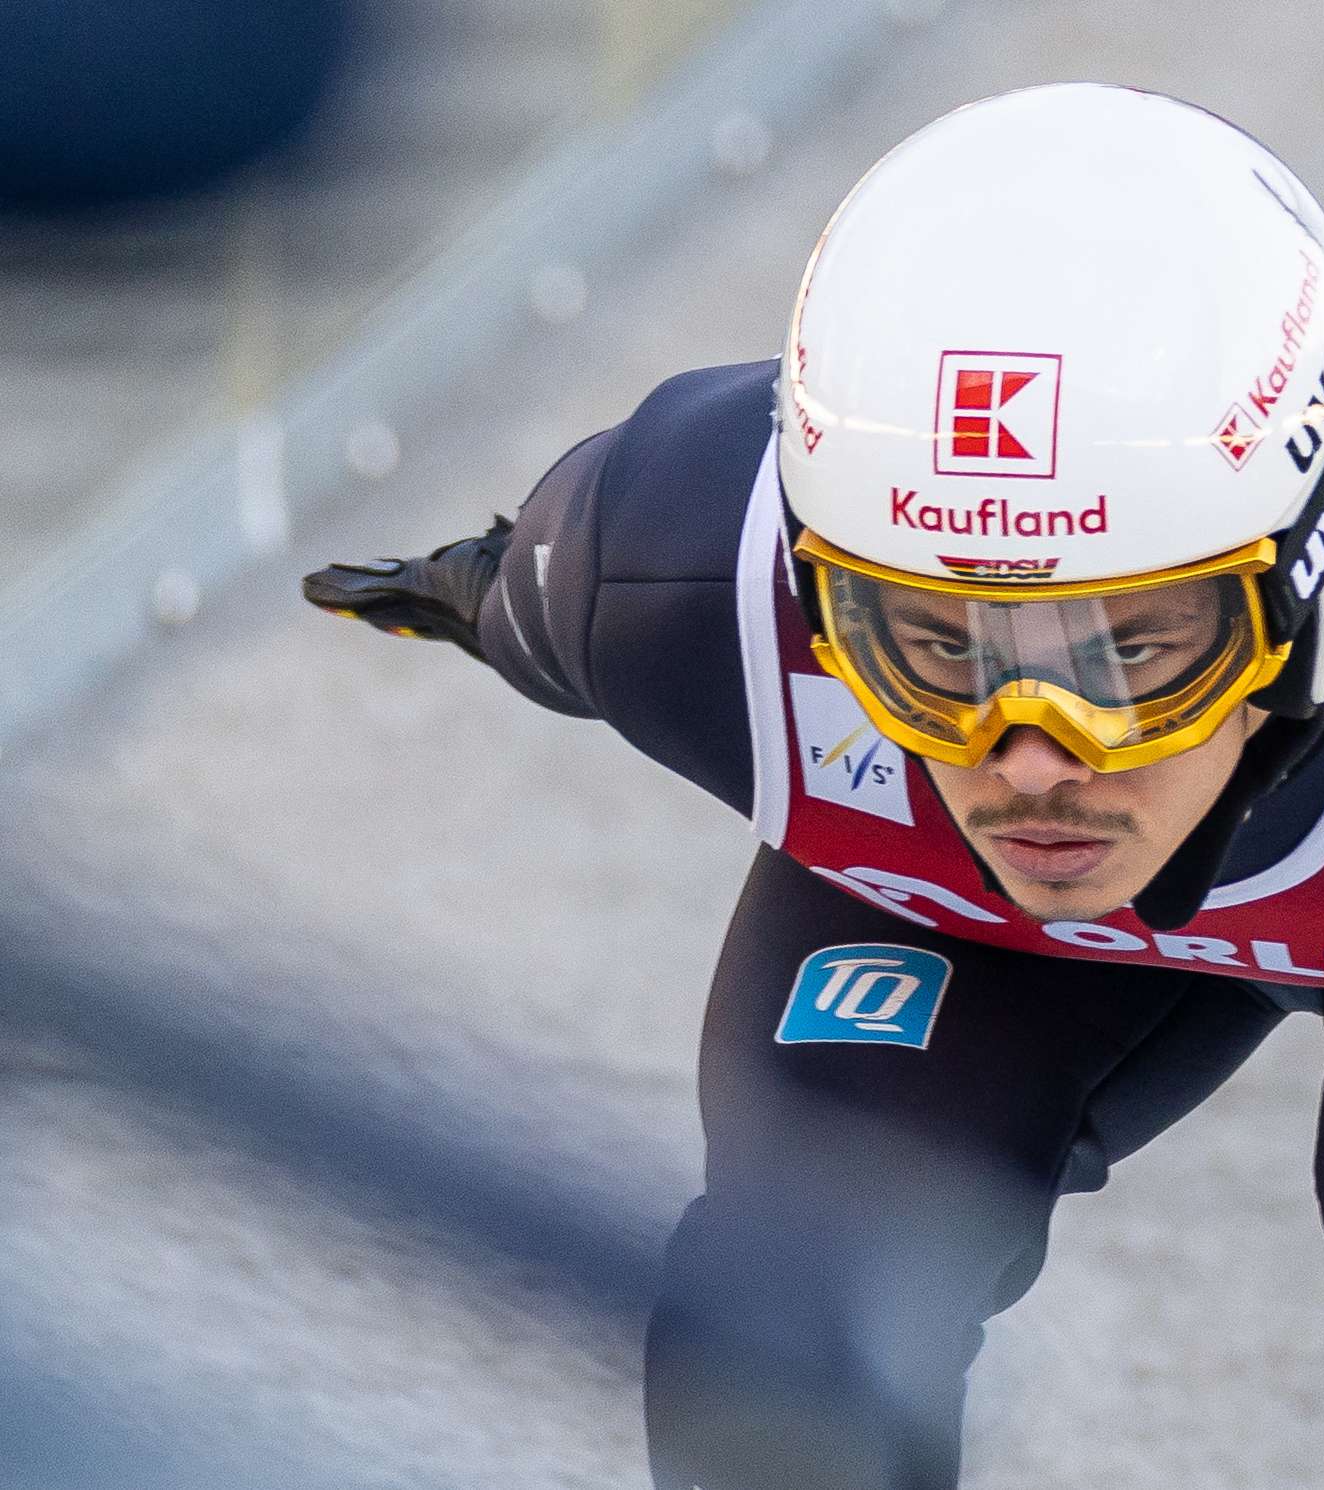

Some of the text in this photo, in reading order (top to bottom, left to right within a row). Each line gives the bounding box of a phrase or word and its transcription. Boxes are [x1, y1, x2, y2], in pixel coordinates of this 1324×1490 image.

[1248, 248, 1321, 418] Kaufland
[890, 486, 1108, 537] Kaufland
[814, 958, 922, 1033] TQ
